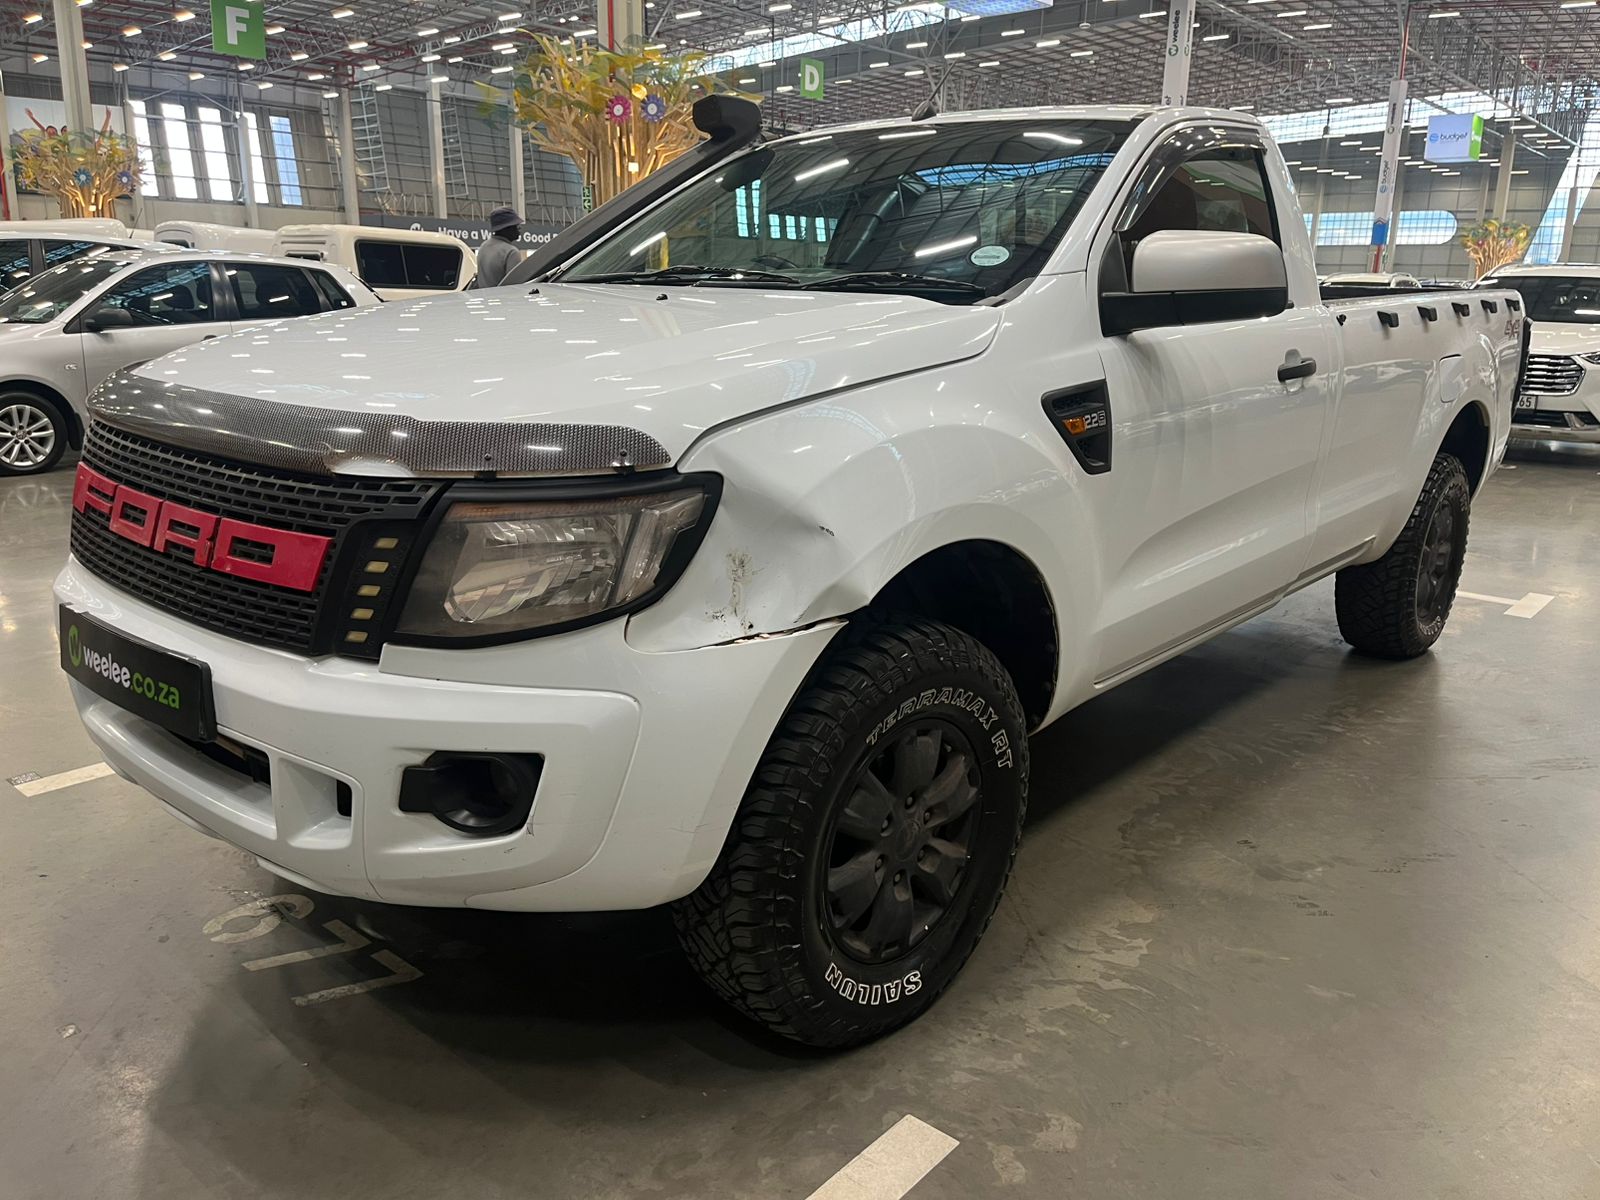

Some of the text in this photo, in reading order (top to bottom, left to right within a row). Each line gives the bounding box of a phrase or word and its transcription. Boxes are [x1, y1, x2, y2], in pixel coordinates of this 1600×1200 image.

[225, 6, 250, 45] F
[1172, 9, 1181, 43] weelee
[805, 64, 820, 91] D
[1440, 131, 1468, 142] budget
[471, 230, 479, 240] a
[523, 231, 551, 243] Good
[73, 461, 334, 592] FORD
[83, 645, 180, 710] weelee.co.za
[866, 687, 1013, 769] TERRAMAX RT
[825, 962, 922, 1005] SAILUN
